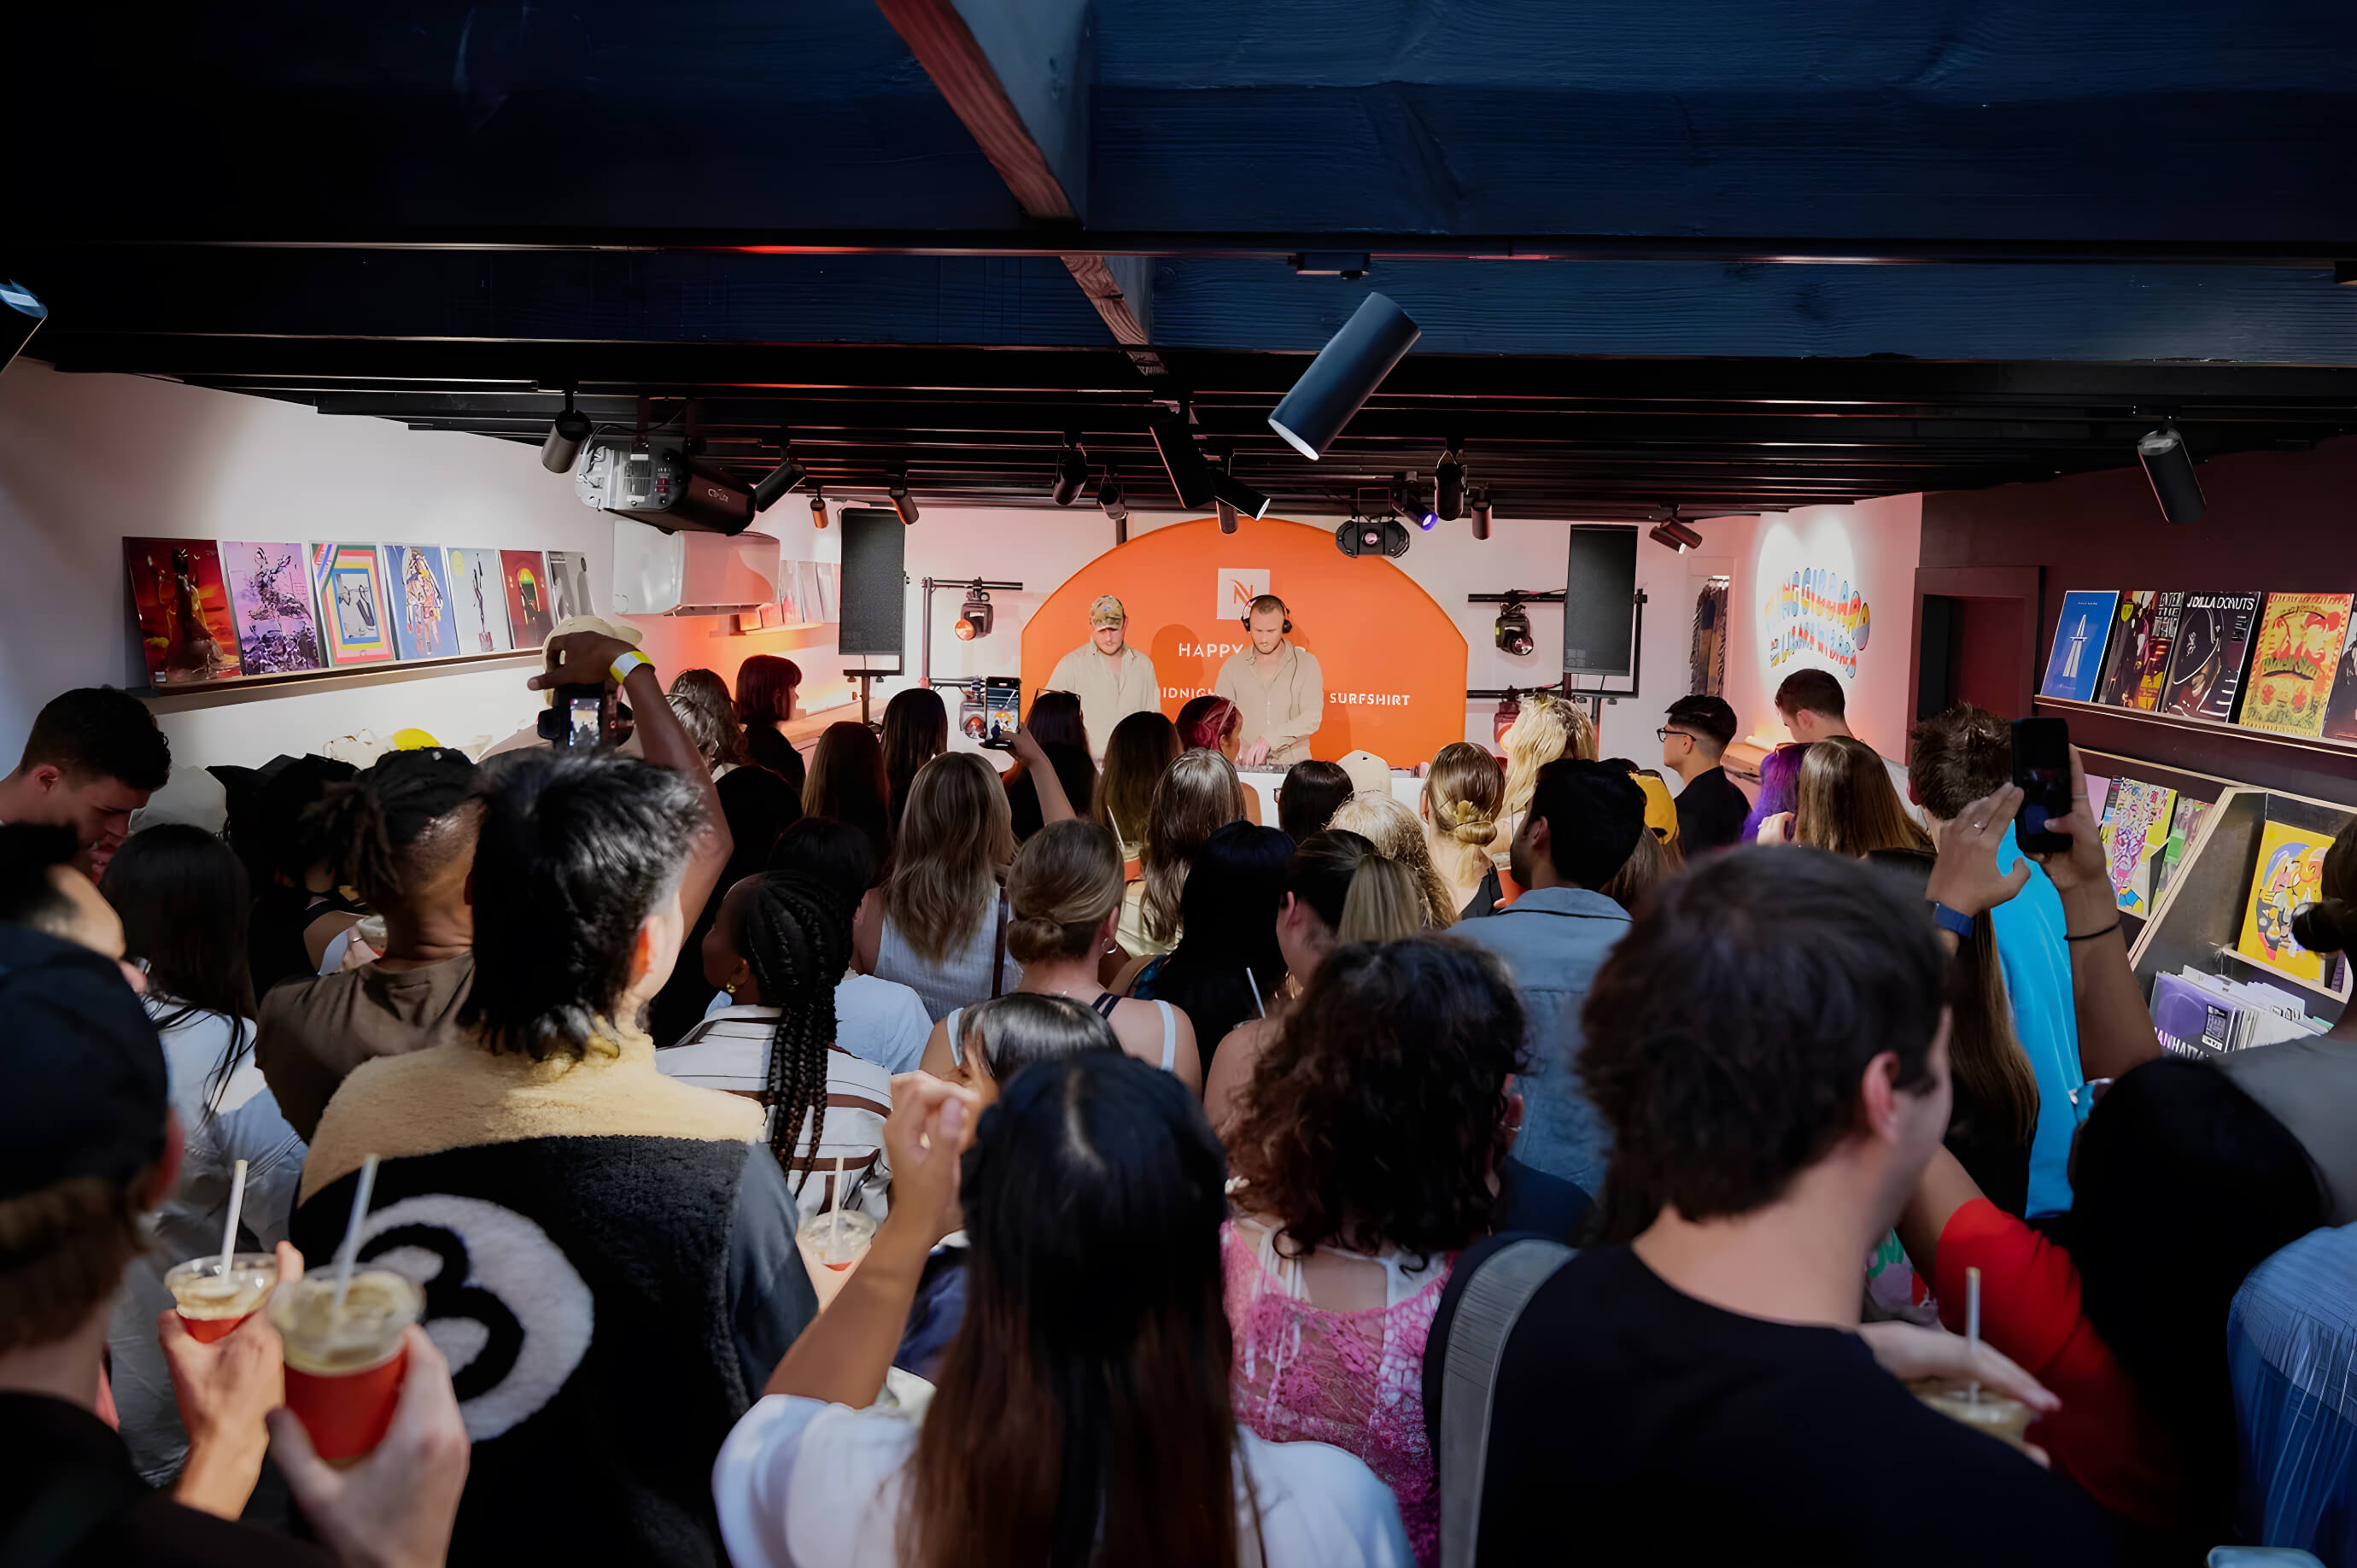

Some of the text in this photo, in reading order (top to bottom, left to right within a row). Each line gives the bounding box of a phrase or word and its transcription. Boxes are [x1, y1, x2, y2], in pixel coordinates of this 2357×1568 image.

[2216, 597, 2255, 611] DONUTS
[1178, 642, 1244, 658] HAPPY
[1329, 693, 1411, 706] SURFSHIRT
